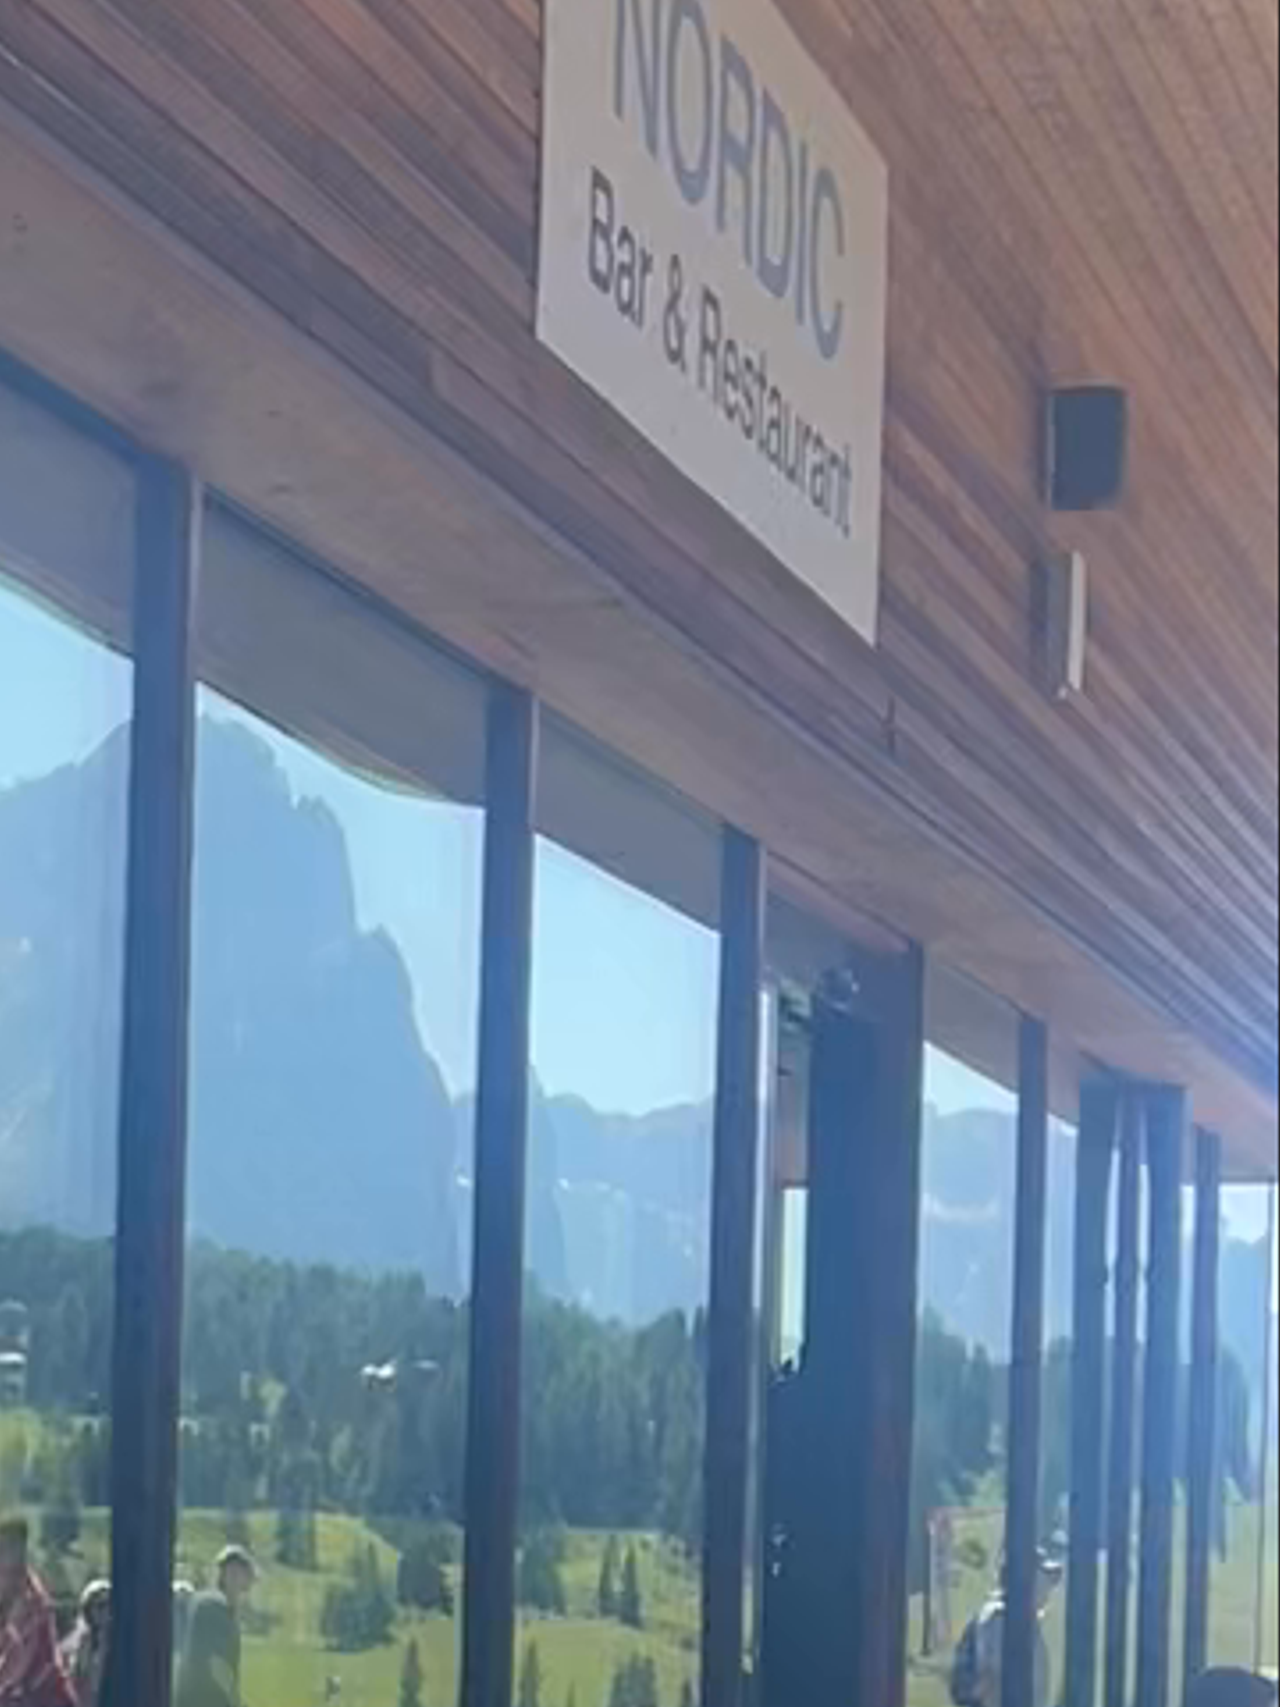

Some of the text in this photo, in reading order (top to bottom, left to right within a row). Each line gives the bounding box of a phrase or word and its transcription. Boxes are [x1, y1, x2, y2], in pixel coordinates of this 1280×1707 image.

[587, 164, 853, 539] Bar & Restaurant
